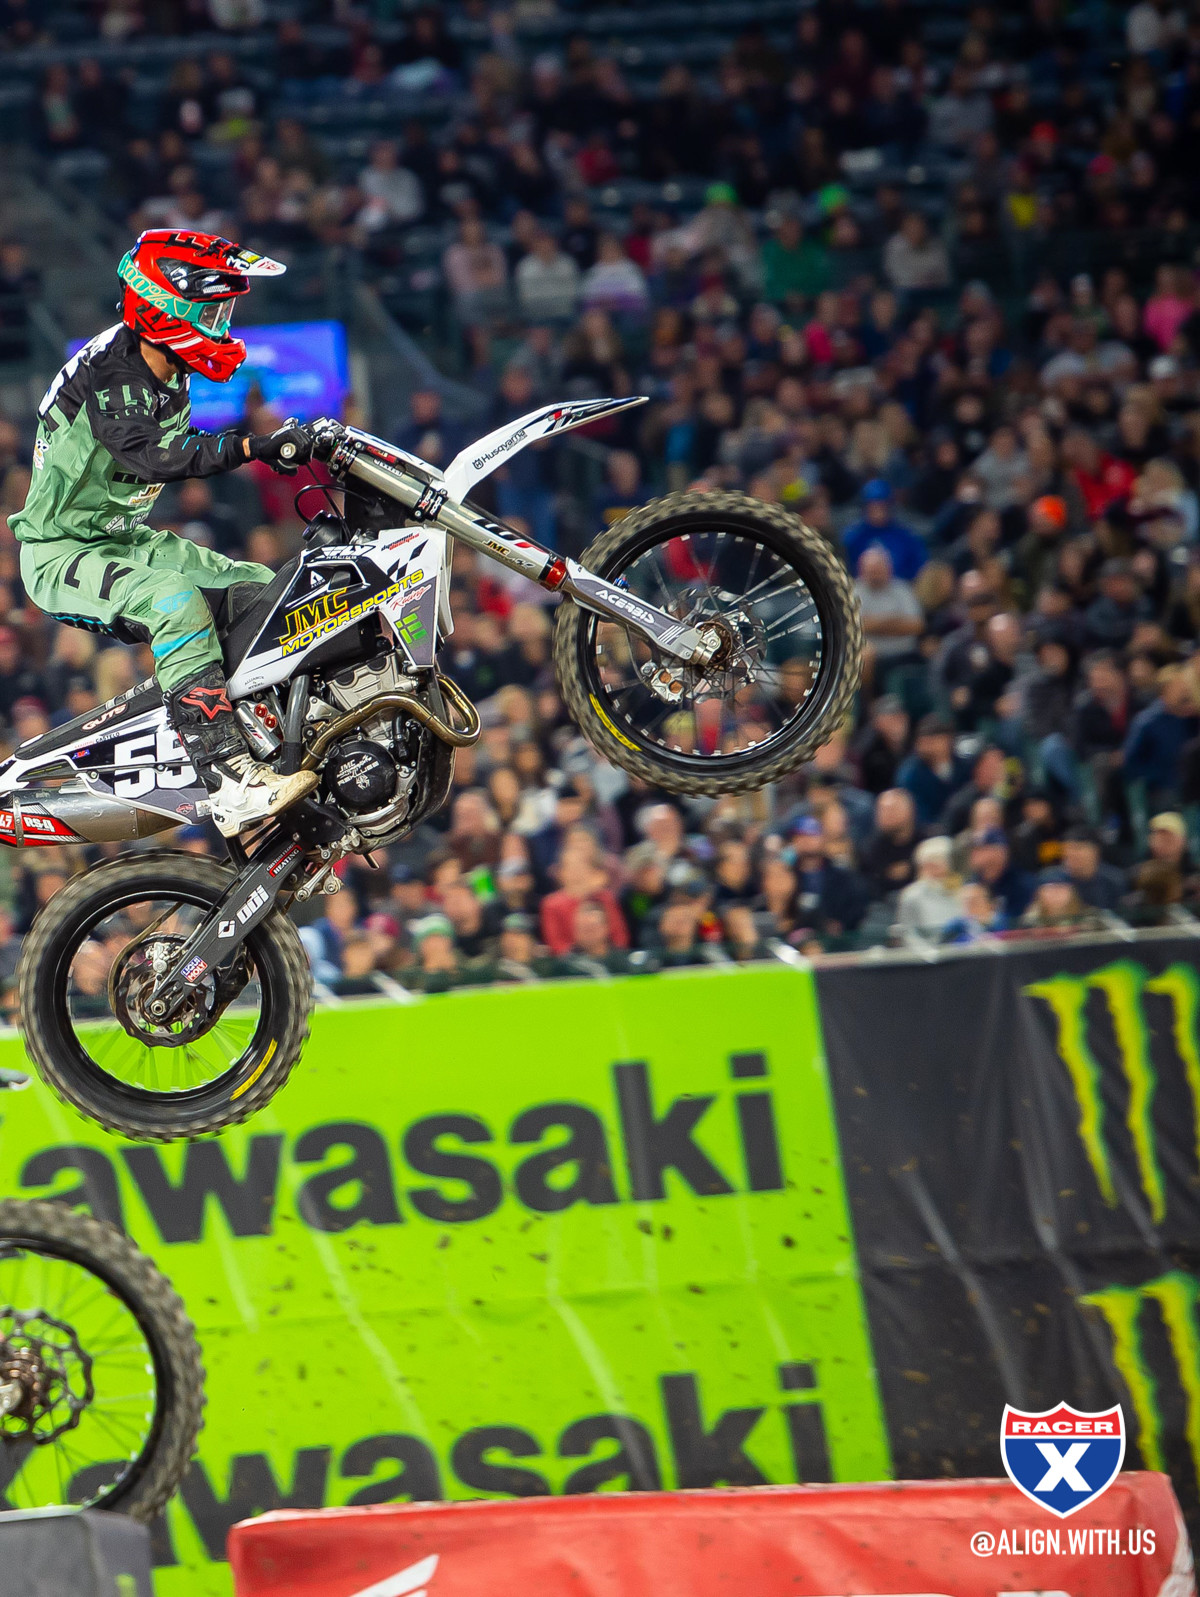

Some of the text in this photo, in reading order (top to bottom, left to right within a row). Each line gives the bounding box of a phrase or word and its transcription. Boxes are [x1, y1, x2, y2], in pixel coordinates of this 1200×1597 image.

[481, 428, 526, 463] Husqvarna
[63, 550, 136, 602] LY
[279, 587, 349, 646] JMC
[281, 568, 425, 658] MOTORSPORTS
[595, 589, 656, 624] ACERBIS
[82, 703, 127, 731] GUTS
[114, 727, 198, 799] 55
[272, 848, 300, 875] HEATING
[187, 962, 207, 982] MOLY
